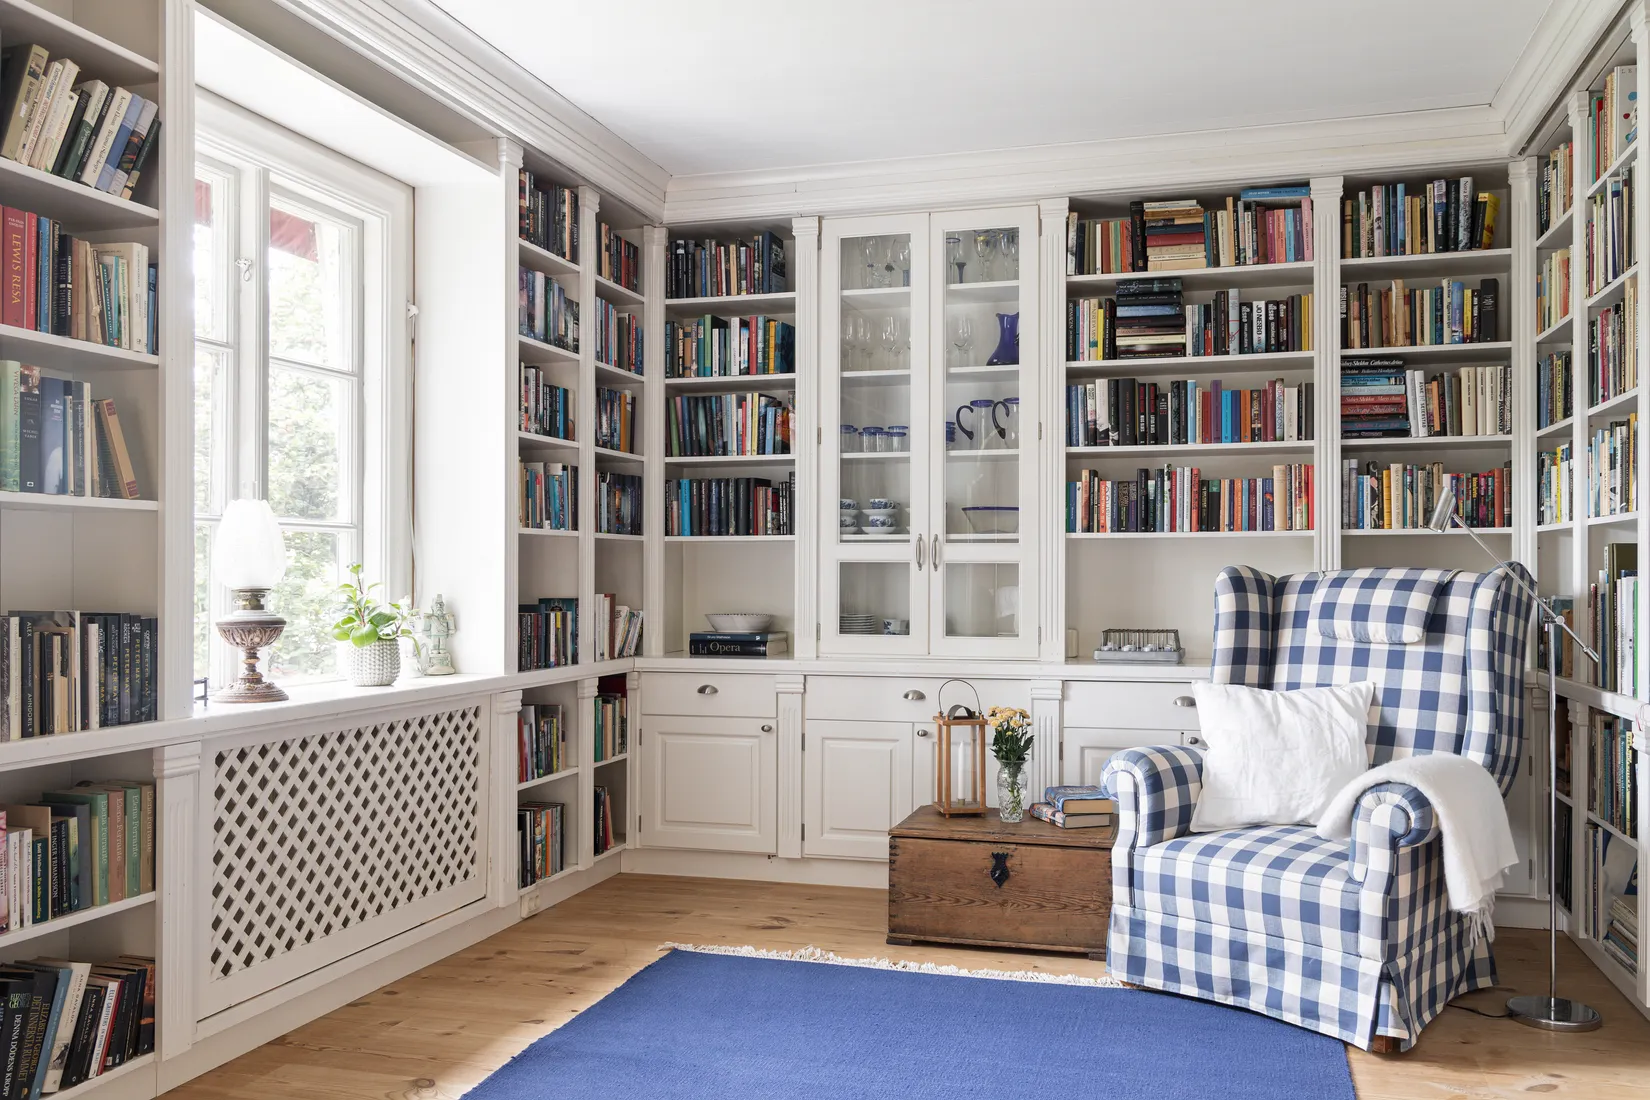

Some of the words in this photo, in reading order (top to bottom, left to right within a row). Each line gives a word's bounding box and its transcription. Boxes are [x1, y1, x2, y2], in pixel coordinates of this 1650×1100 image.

[12, 234, 22, 271] LEWIS
[12, 274, 21, 304] RESA
[1256, 305, 1263, 313] JO
[710, 642, 740, 653] Opera
[31, 996, 42, 1012] DET
[89, 994, 97, 1012] ANNA
[107, 989, 115, 1001] ELLY
[12, 1014, 22, 1040] DENNA
[23, 1012, 39, 1049] INNERSTA
[36, 1003, 50, 1043] ELIZABETH
[6, 1041, 17, 1073] DÖDENS
[18, 1049, 32, 1082] RUMMET
[29, 1044, 41, 1074] GEORGE
[2, 1073, 12, 1097] KROPP
